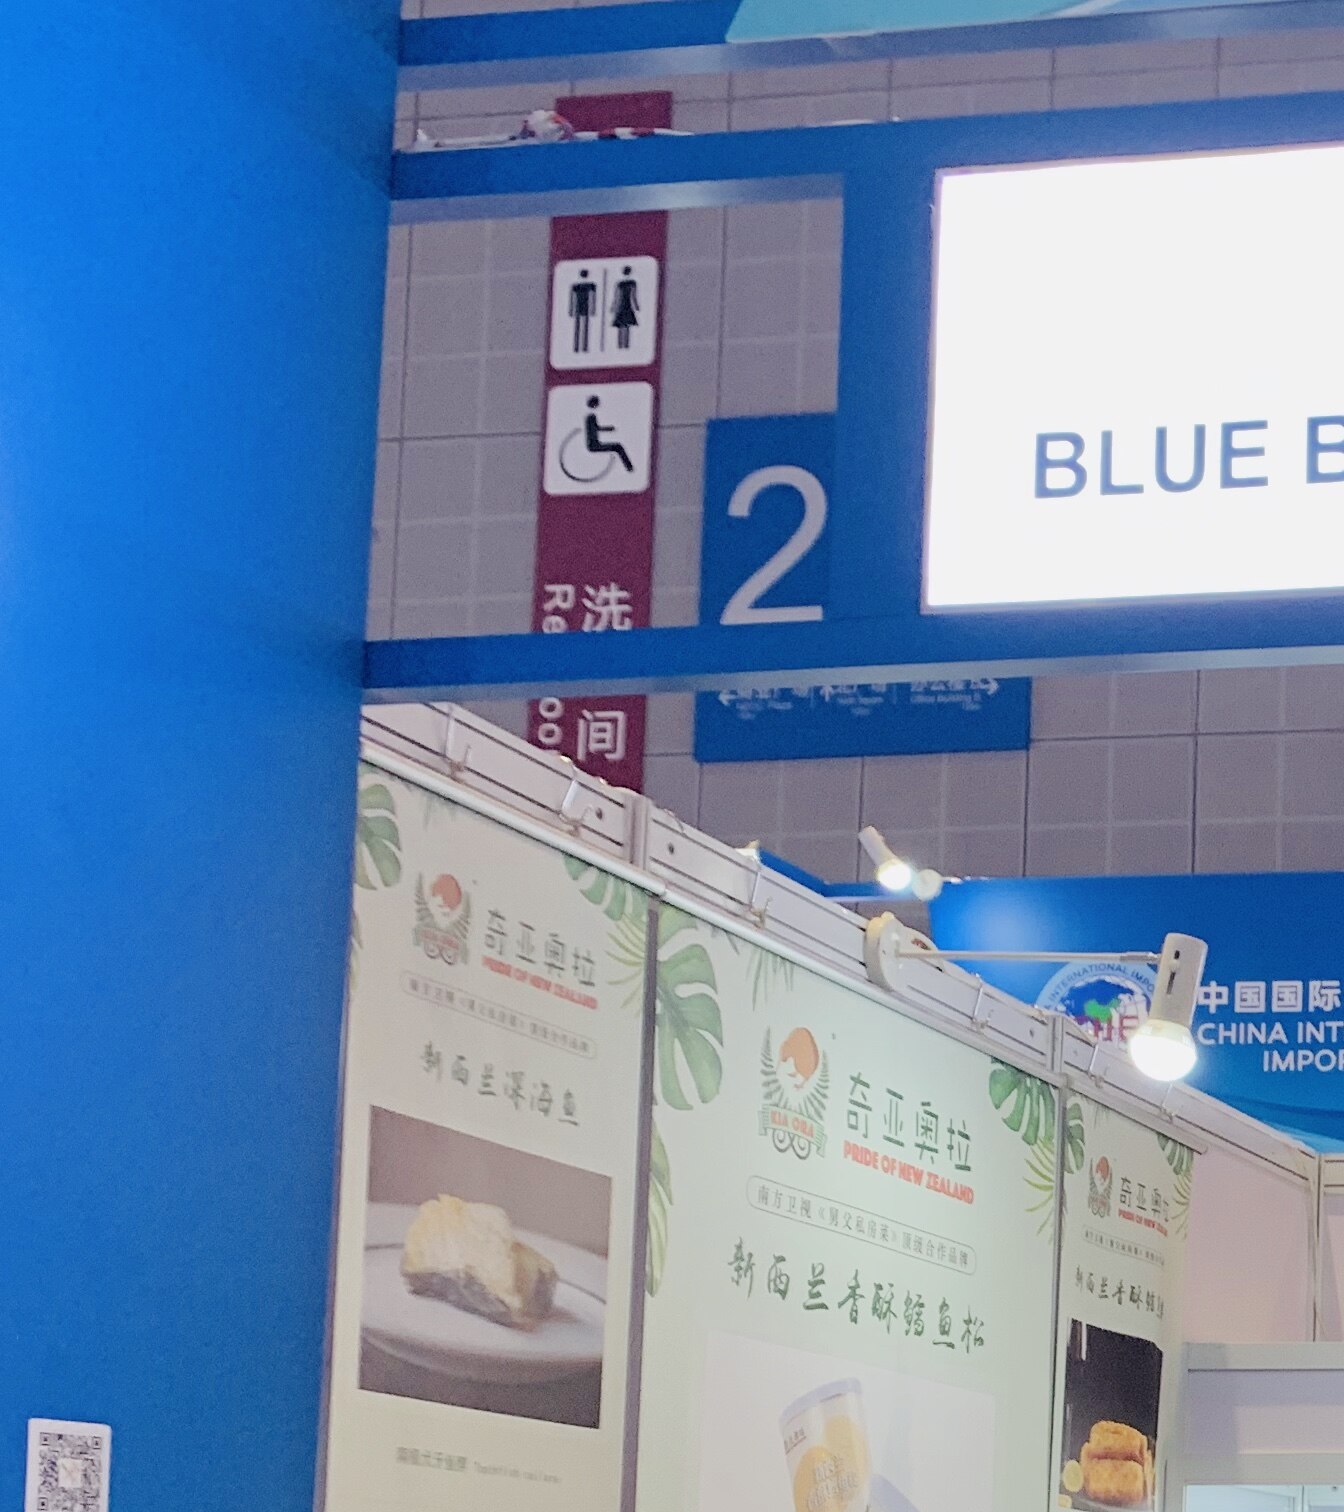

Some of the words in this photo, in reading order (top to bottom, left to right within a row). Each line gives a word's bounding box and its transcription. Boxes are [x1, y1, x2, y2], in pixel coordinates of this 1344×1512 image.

[1031, 419, 1270, 500] BLUE
[718, 463, 829, 626] 2
[1197, 1021, 1288, 1046] CHINA
[843, 1071, 974, 1173] 奇亚奥拉
[842, 1139, 880, 1171] PRIDE
[881, 1152, 898, 1176] OF
[898, 1158, 925, 1187] NEW
[925, 1169, 975, 1205] ZEALAND
[726, 1236, 986, 1354] 新西兰香酥鳕鱼松
